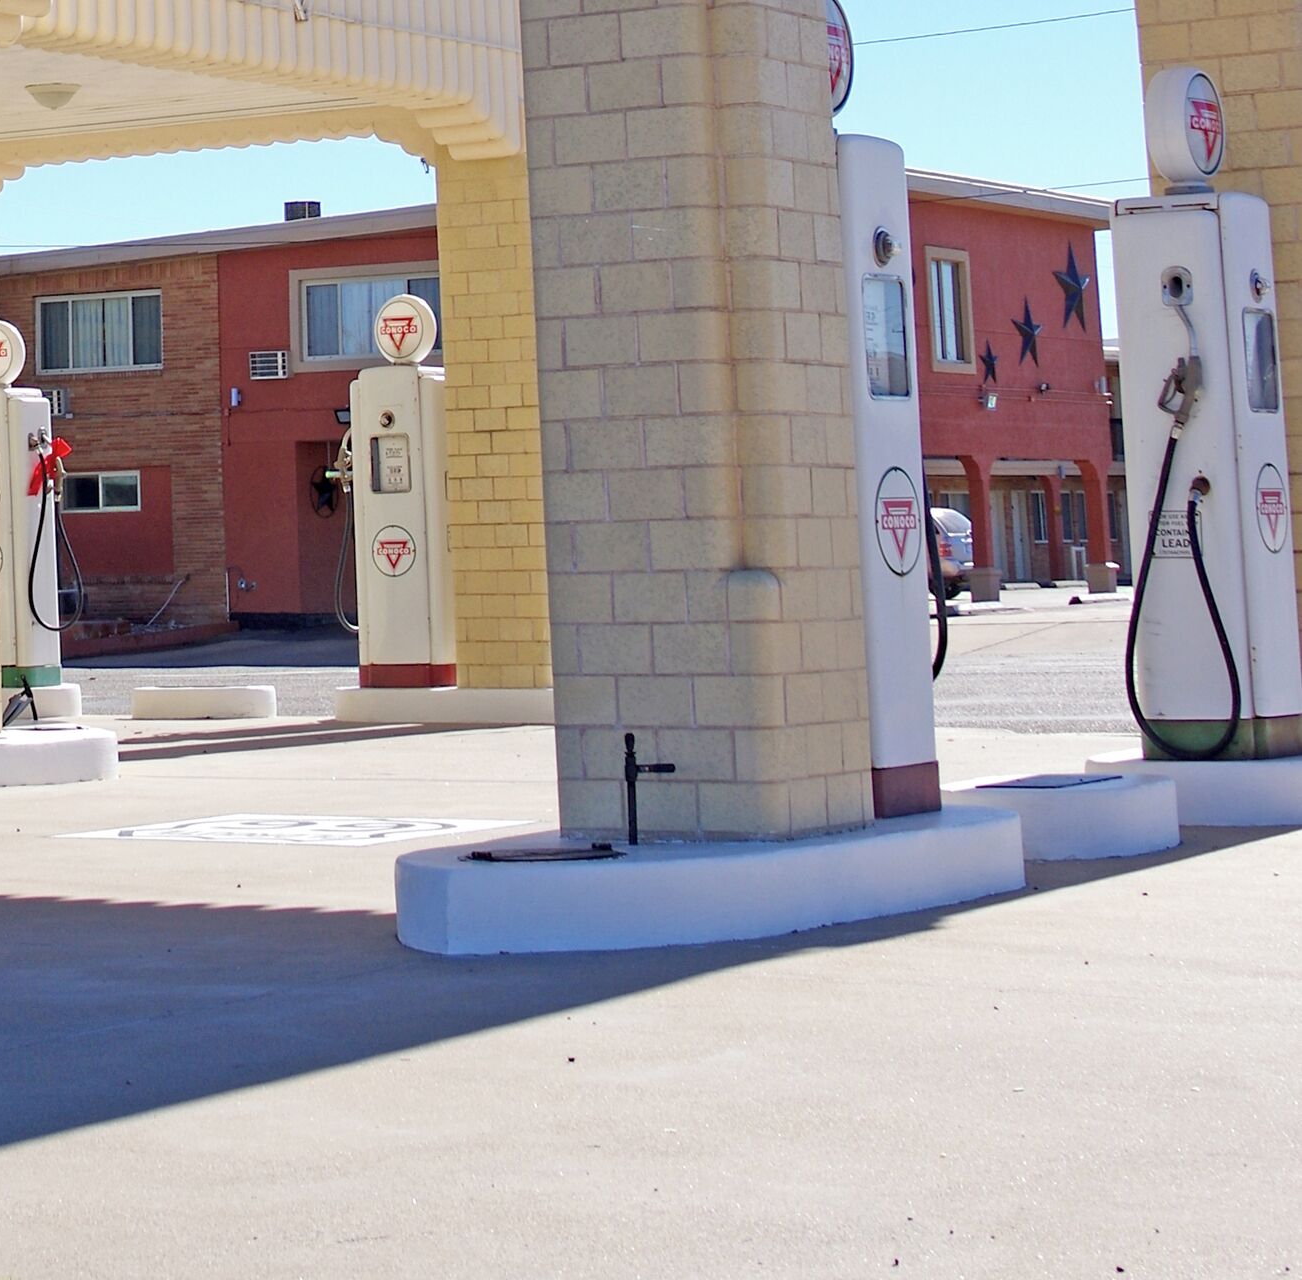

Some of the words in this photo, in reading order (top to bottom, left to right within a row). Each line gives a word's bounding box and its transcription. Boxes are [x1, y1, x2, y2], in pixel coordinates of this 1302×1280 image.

[380, 325, 418, 335] CONOCO
[882, 514, 916, 529] CONOCO
[1161, 538, 1192, 548] LEAD
